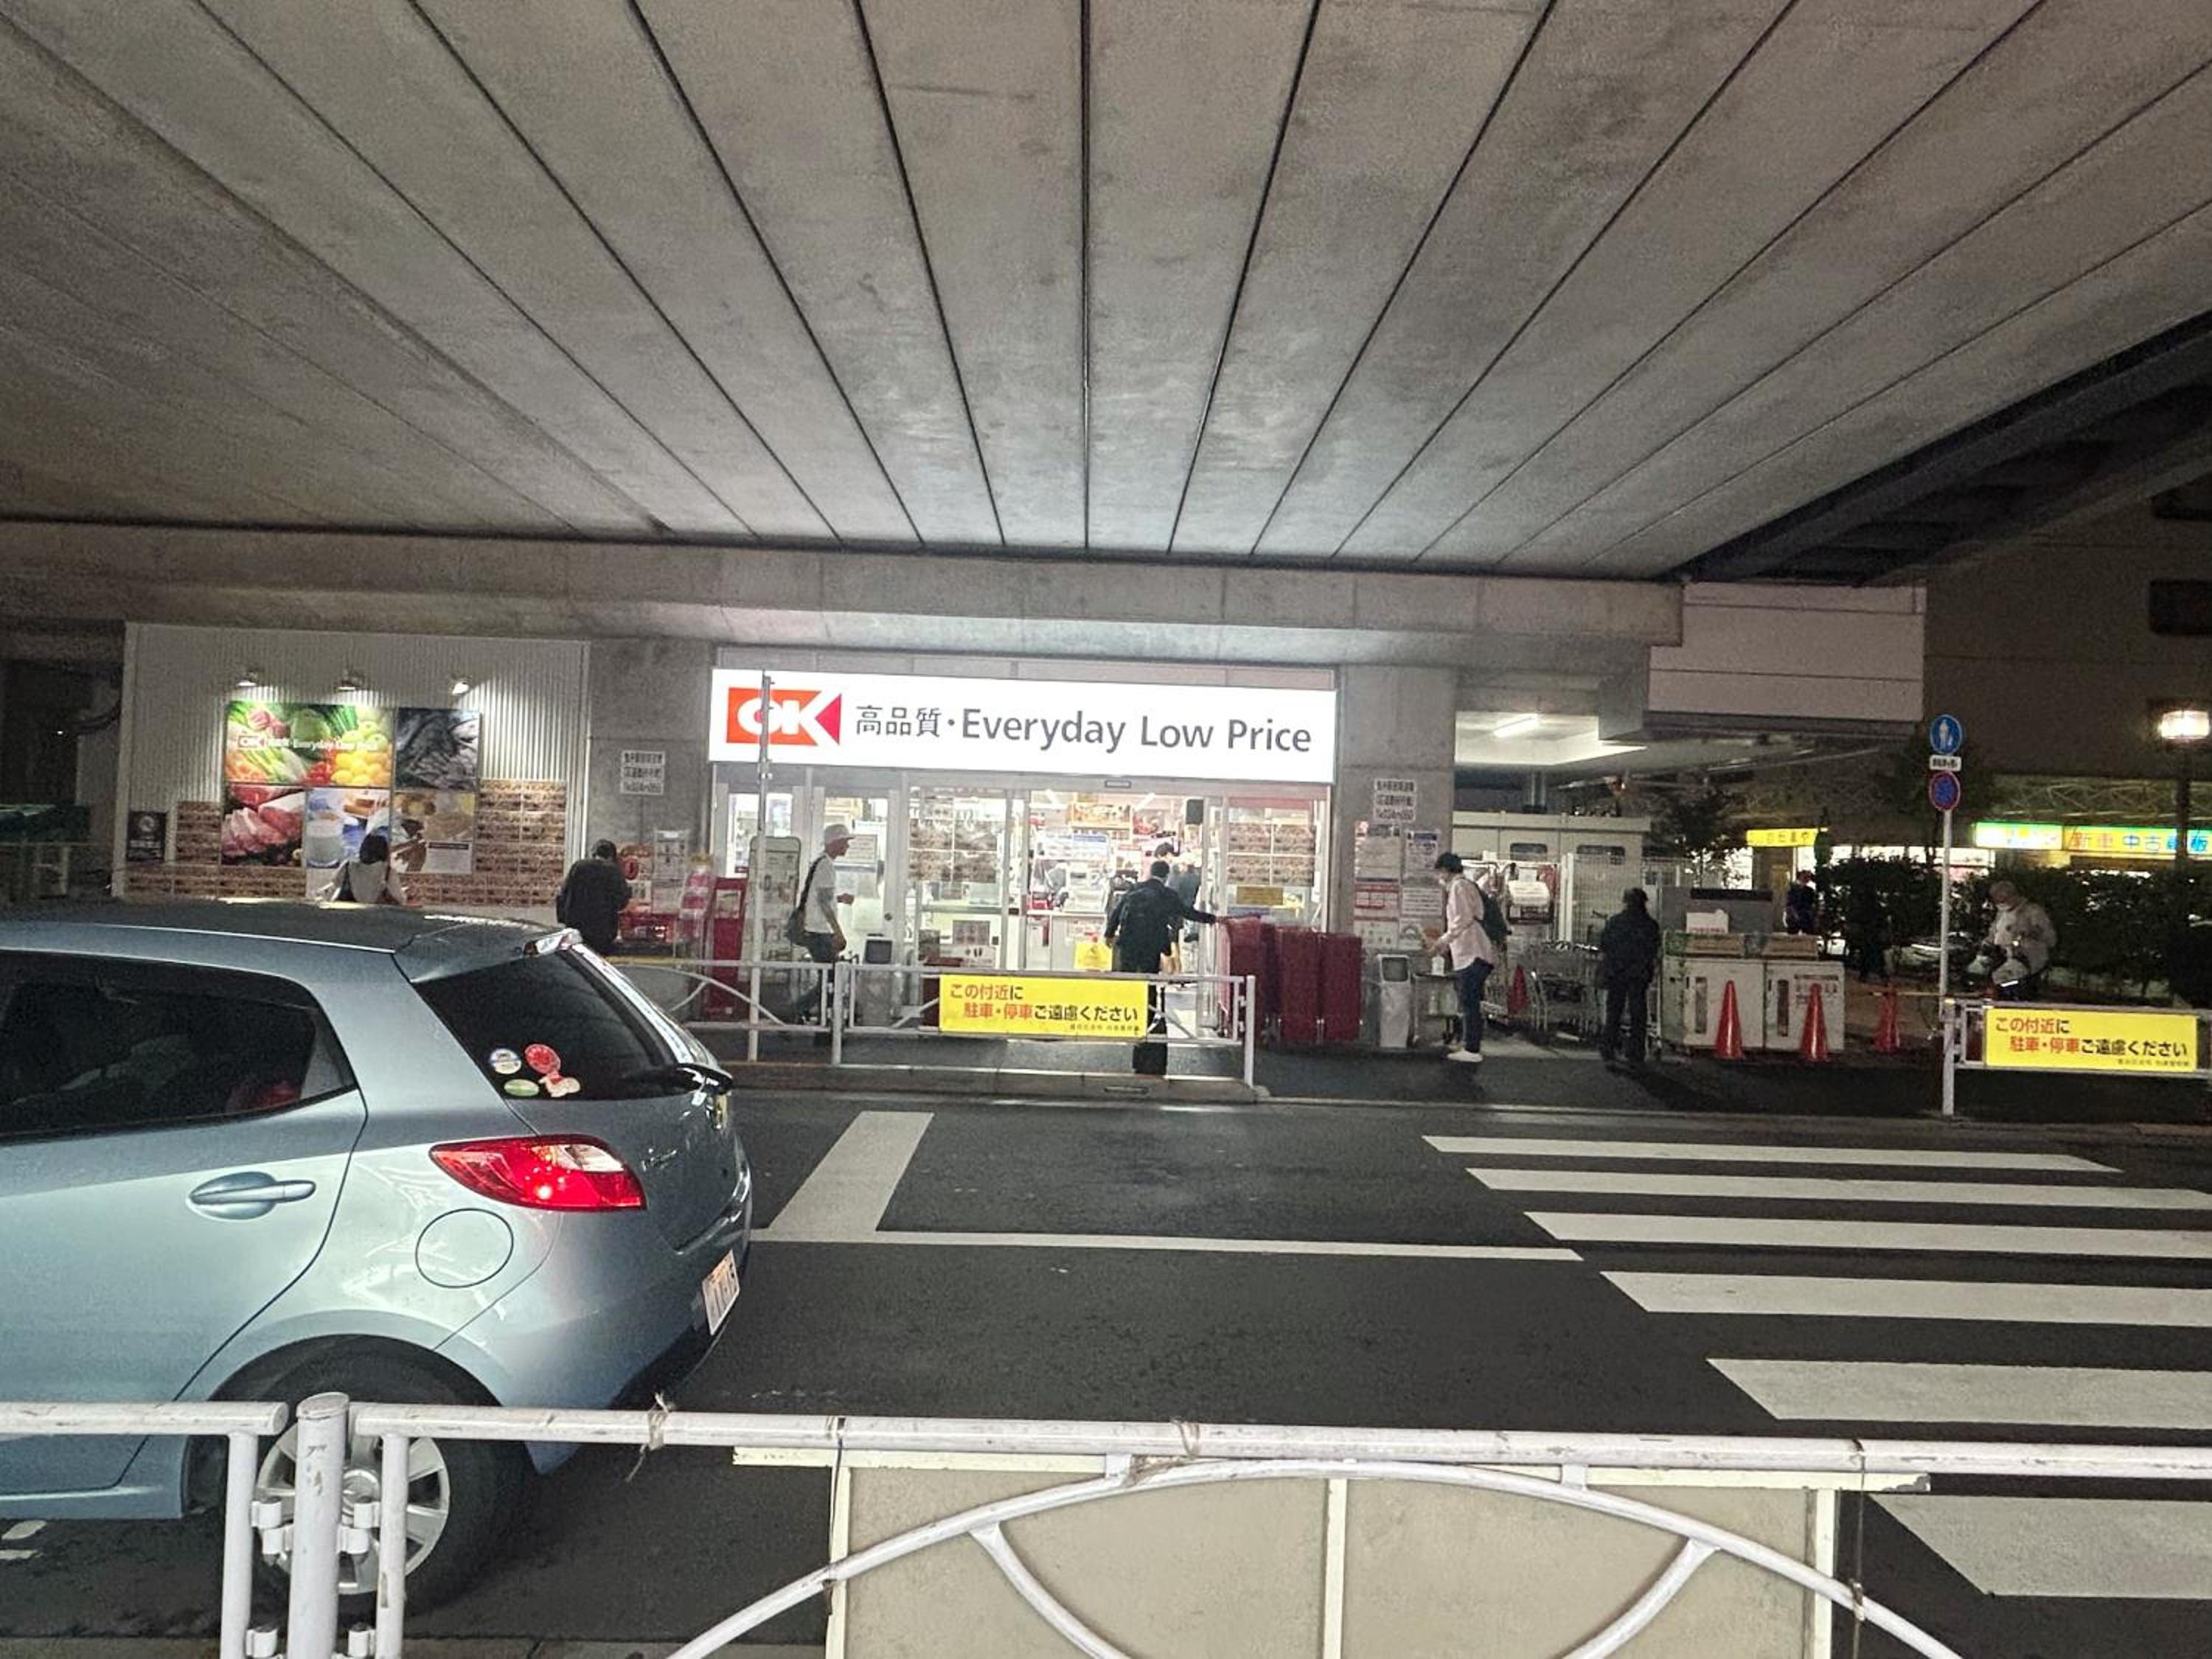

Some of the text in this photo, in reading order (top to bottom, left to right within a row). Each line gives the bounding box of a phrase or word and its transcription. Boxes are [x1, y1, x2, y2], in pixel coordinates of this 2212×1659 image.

[736, 688, 841, 745] OK
[1140, 715, 1214, 748] Low
[1227, 718, 1312, 752] Price
[950, 983, 1023, 1001] この付近に
[963, 1001, 1138, 1022] 駐車・停車ご遠慮ください
[1995, 1017, 2070, 1033] この付近に
[2009, 1035, 2188, 1057] 駐車・停車ご遠慮ください
